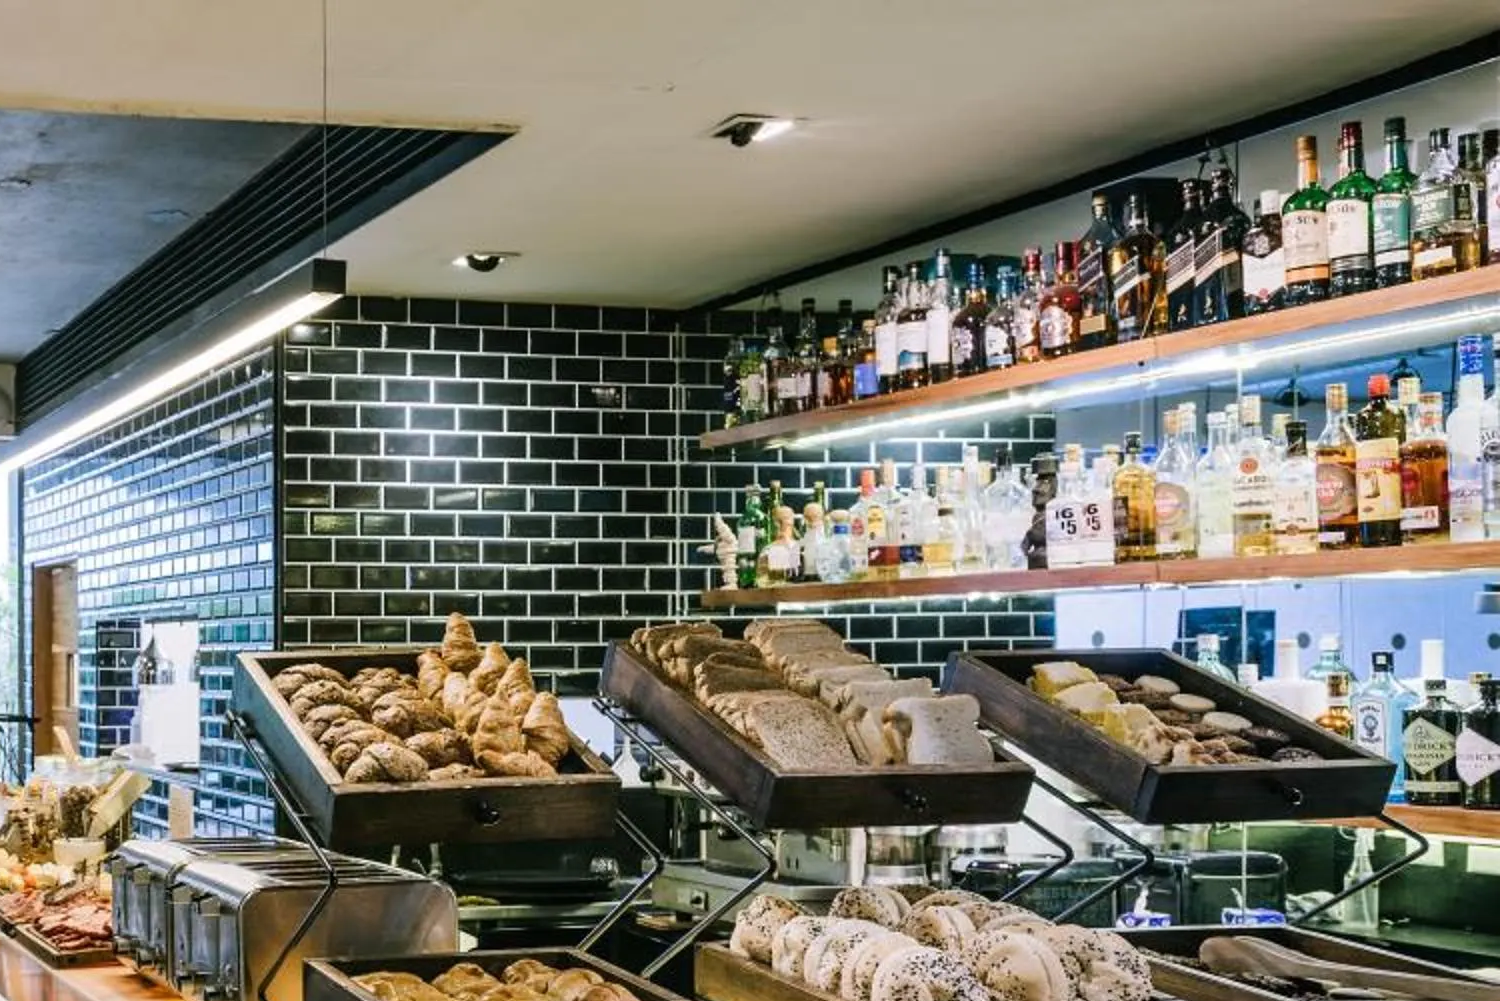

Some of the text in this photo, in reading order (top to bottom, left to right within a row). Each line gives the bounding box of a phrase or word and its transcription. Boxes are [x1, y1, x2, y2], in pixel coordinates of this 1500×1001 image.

[1055, 508, 1074, 520] 16
[1061, 520, 1077, 535] 15
[1086, 516, 1101, 531] 15
